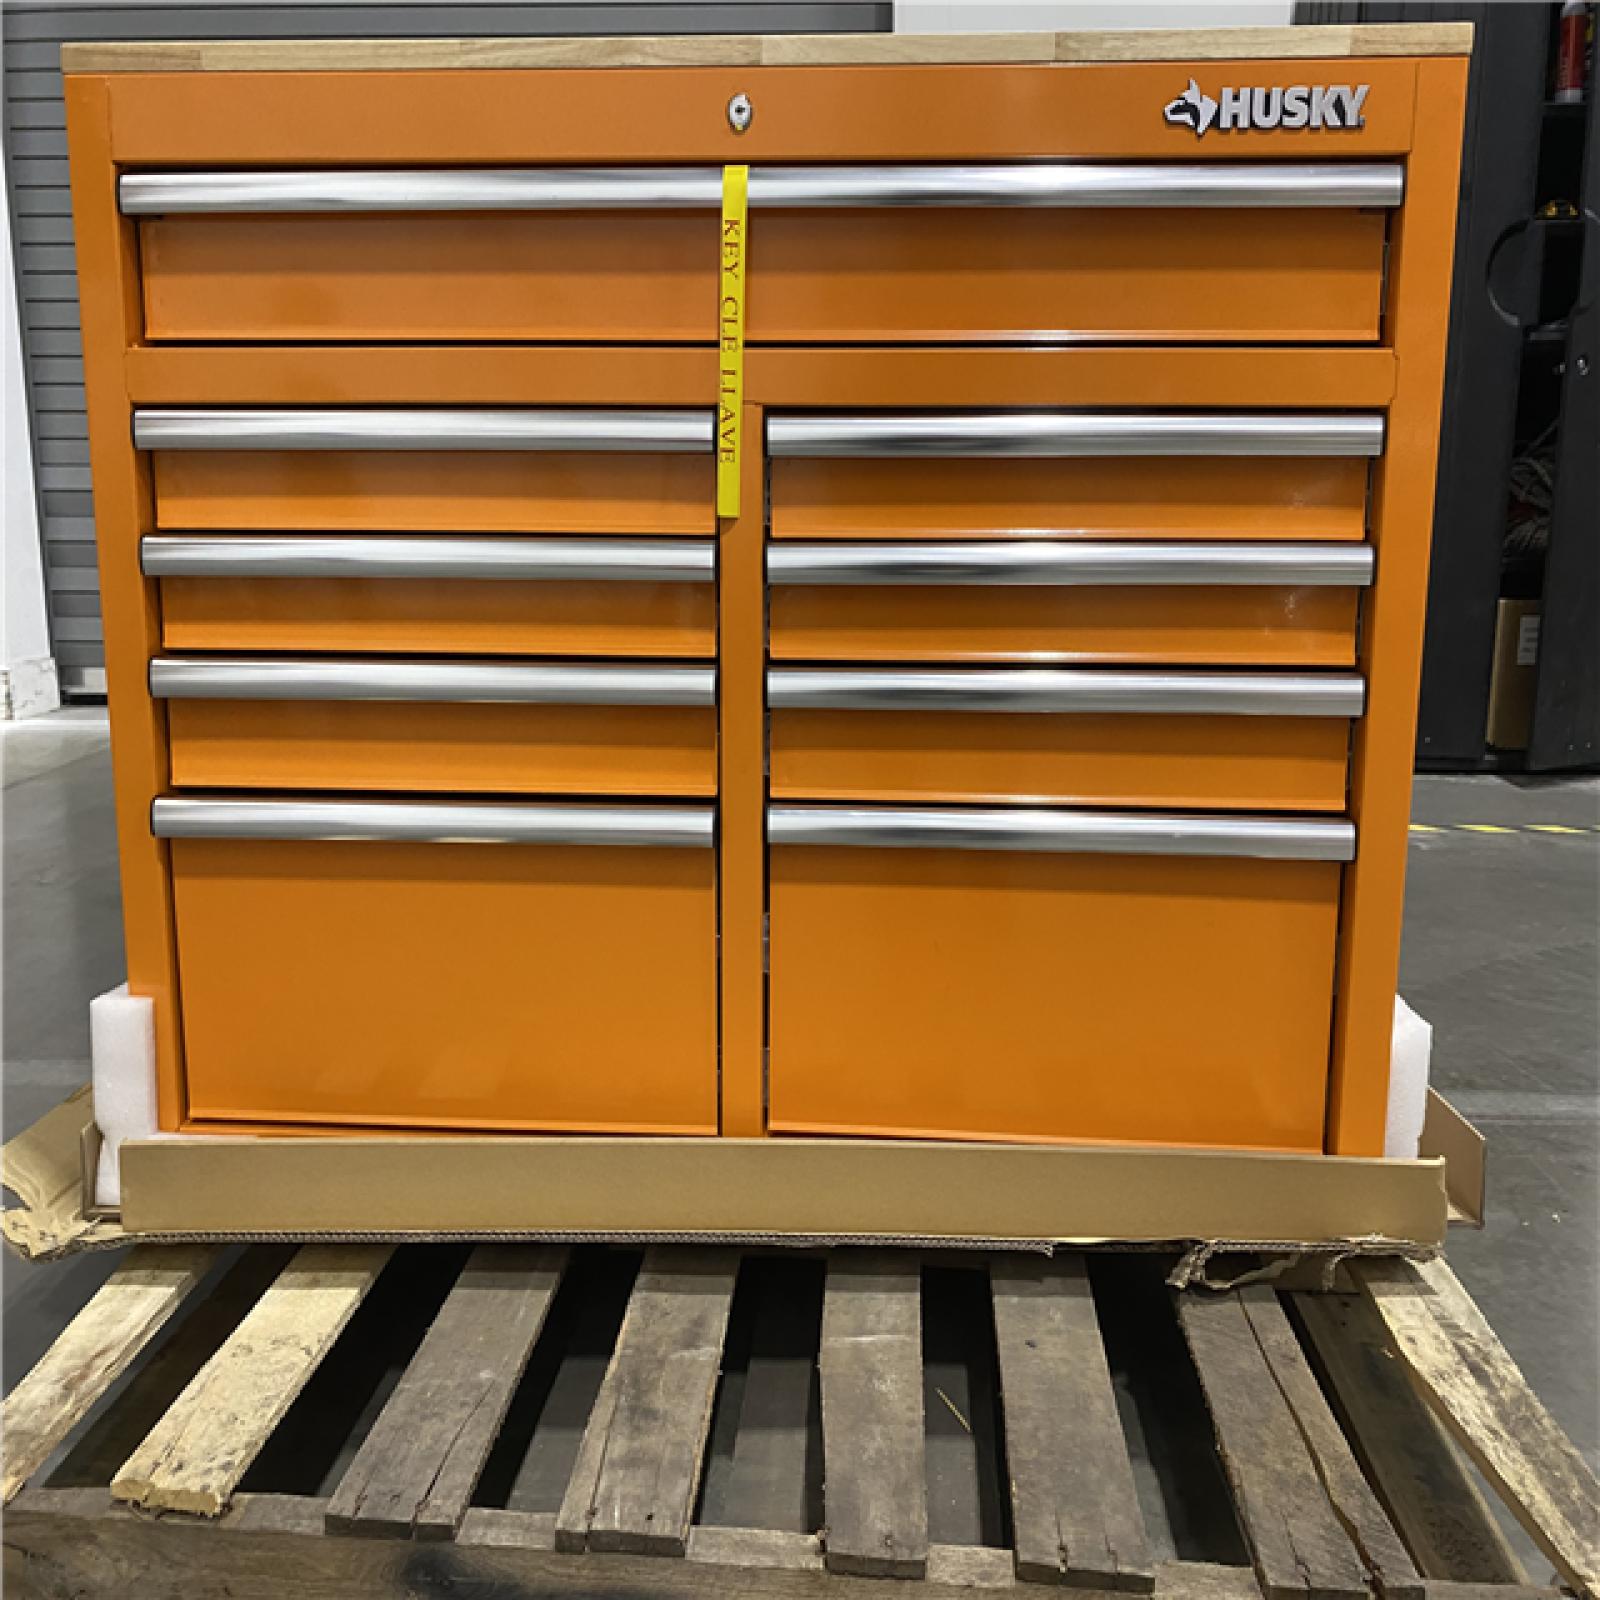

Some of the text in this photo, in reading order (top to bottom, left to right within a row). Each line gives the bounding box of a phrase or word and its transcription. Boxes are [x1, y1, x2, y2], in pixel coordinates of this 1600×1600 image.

[1219, 85, 1369, 129] HUSKY
[723, 218, 741, 280] KEY
[719, 369, 738, 464] LLAVE
